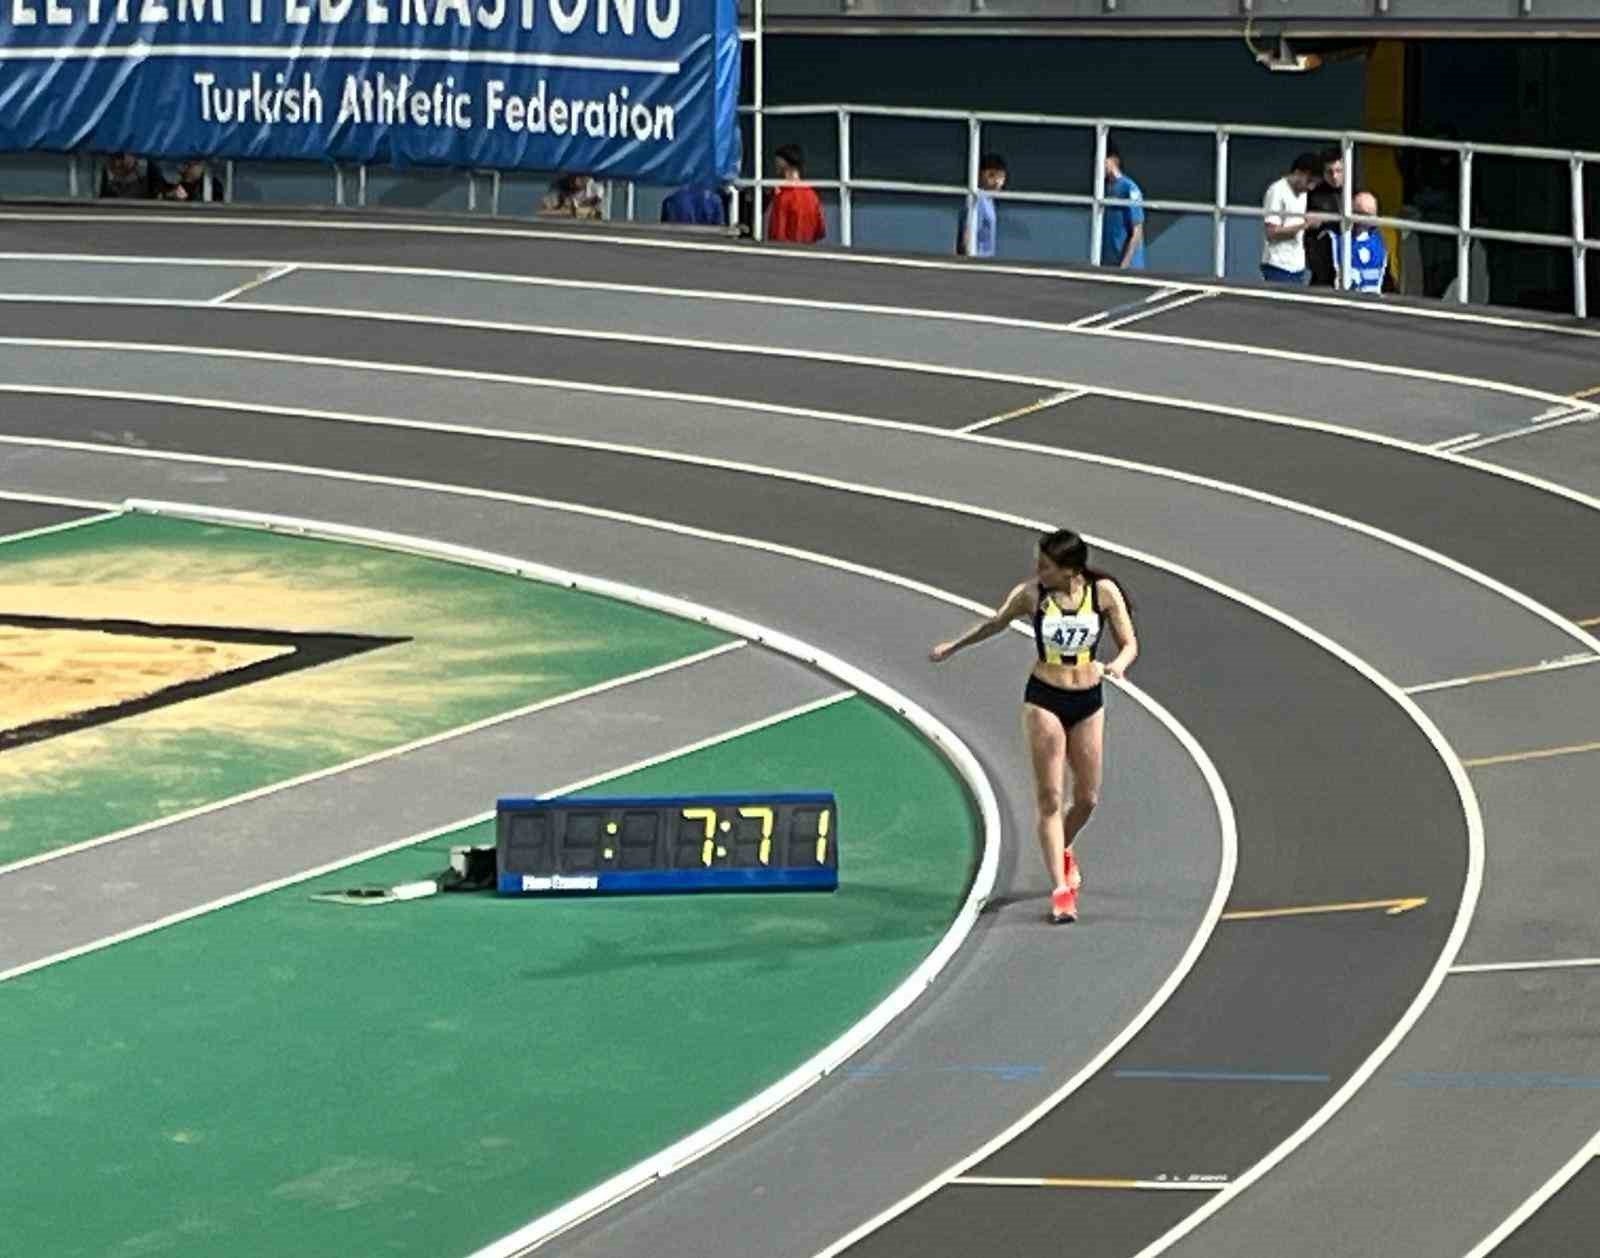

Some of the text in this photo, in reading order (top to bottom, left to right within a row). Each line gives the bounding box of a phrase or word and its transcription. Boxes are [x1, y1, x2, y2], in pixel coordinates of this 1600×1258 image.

[193, 71, 675, 141] Turkish Athletic Federation
[1051, 628, 1089, 645] 477
